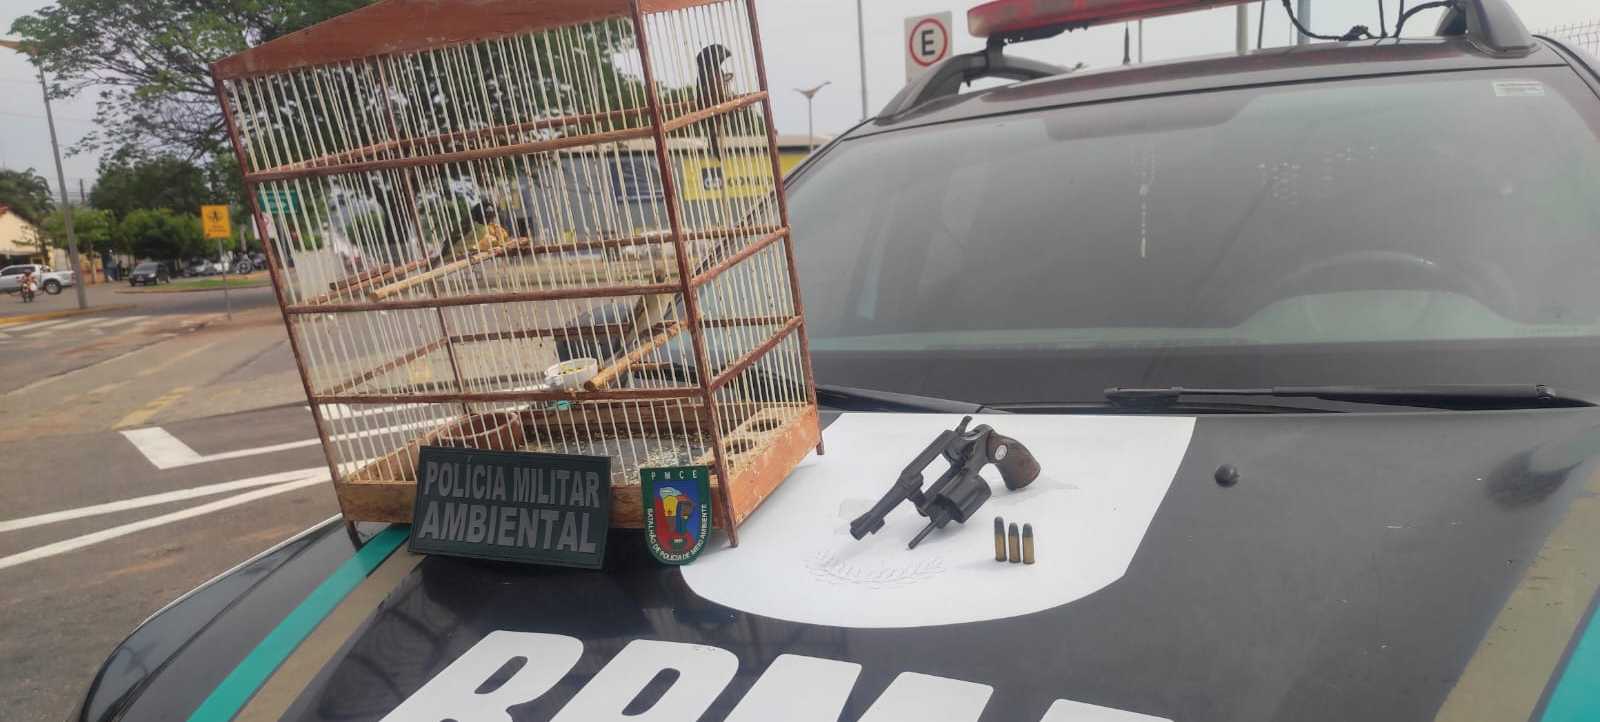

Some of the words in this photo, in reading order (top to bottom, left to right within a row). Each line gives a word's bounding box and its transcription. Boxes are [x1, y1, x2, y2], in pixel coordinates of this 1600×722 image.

[921, 29, 935, 55] E
[424, 456, 506, 501] POLÍCIA
[512, 467, 600, 508] MILITAR
[418, 501, 597, 553] AMBIENTAL
[378, 630, 1177, 722] BP
